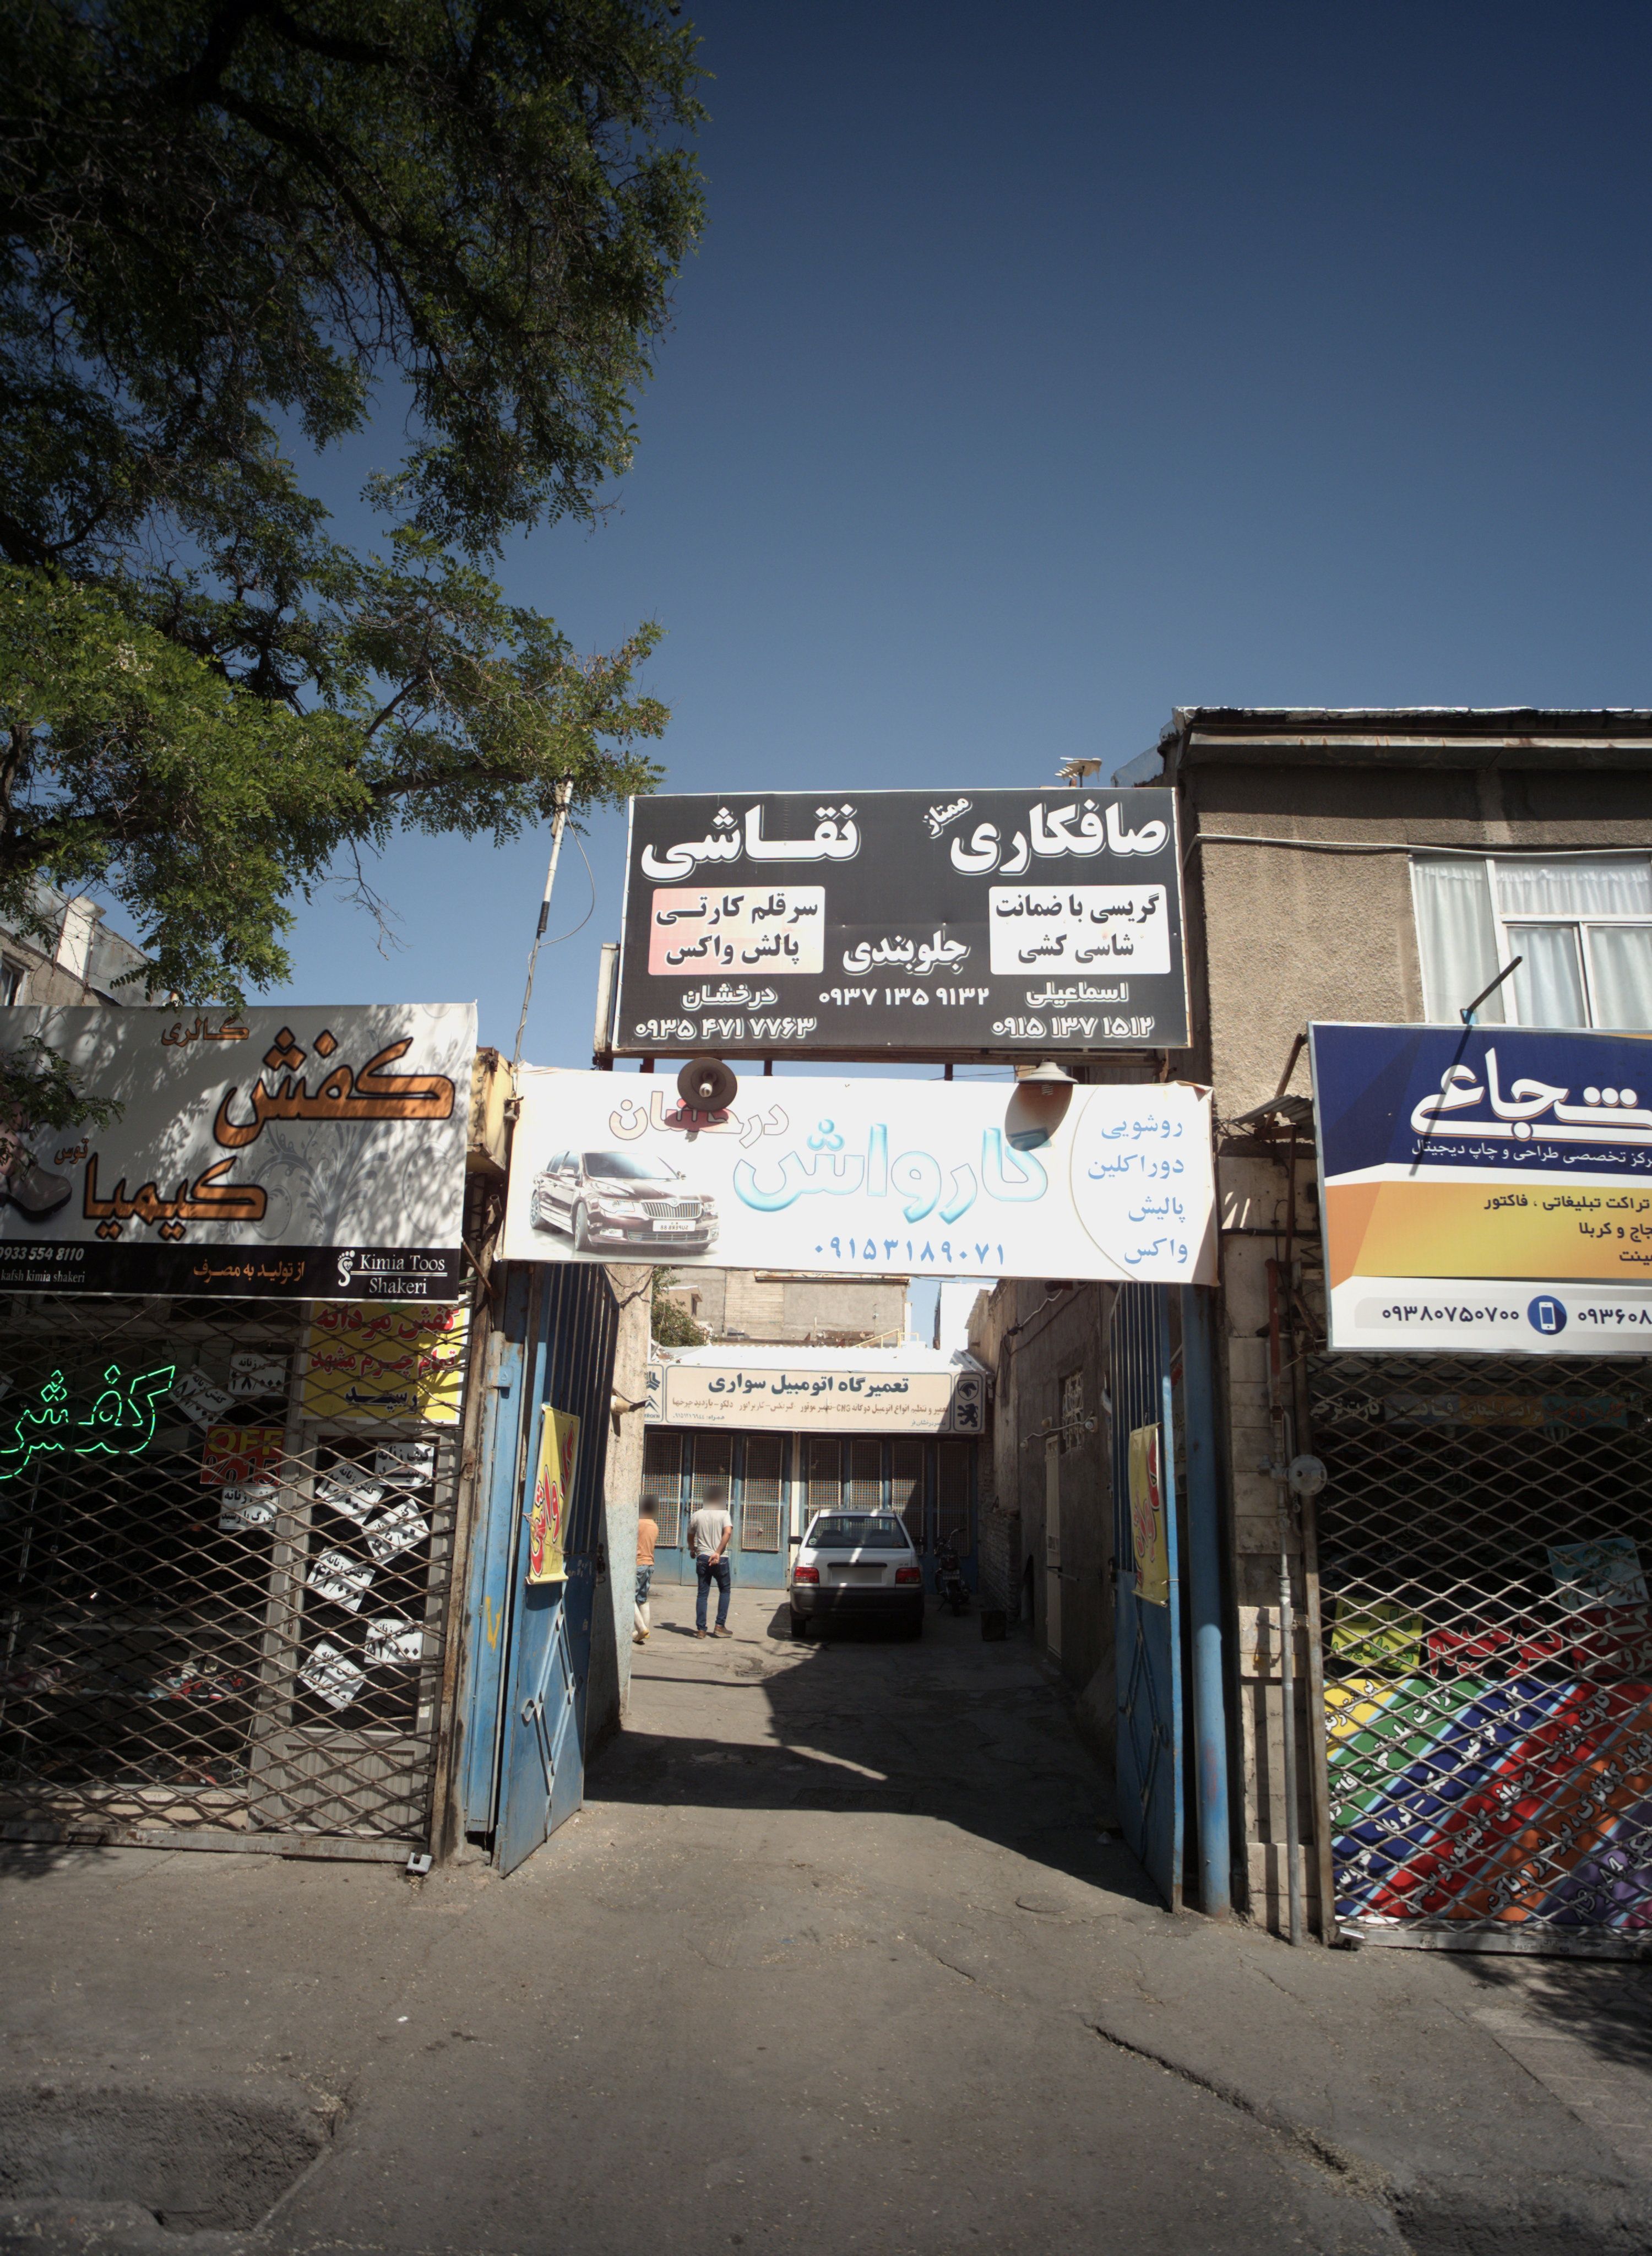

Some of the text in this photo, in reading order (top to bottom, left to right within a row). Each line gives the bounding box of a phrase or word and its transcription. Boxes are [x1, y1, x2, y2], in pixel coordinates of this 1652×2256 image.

[923, 798, 972, 838] ممتاز
[641, 799, 1170, 882] صافکاری نقاشی
[656, 895, 745, 925] کارتی
[996, 892, 1160, 924] گریسی با ضمانت
[742, 934, 799, 965] پالش
[843, 930, 971, 975] جلوبندی
[1018, 934, 1134, 963] شاسی کشی
[681, 982, 778, 1010] درخشان
[819, 988, 990, 1005] ۰۹۳۷ ۱۳۵ ۹۱۳۲
[1025, 981, 1130, 1007] اسماعیلی
[634, 1016, 817, 1039] ۰۹۳۵ ۴۷۱ ۷۷۶۳
[992, 1015, 1155, 1038] ۰۹۱۵ ۱۳۷ ۱۵۱۲
[214, 1027, 455, 1148] کفش
[1101, 1114, 1183, 1140] روشویی
[1411, 1138, 1652, 1168] رکز تخصصی طراحی و چاپ دیجیتال
[733, 1118, 1052, 1225] کارواش
[83, 1153, 268, 1240] کیمیا
[1128, 1196, 1185, 1223] پالیش
[1484, 1194, 1650, 1212] تراکت تبلیغاتی فاکتور
[1579, 1222, 1612, 1238] کربلا
[1617, 1226, 1624, 1238] و
[29, 1247, 54, 1261] 554
[56, 1248, 85, 1261] 8110
[360, 1254, 445, 1271] Kimia Toos
[814, 1236, 1005, 1265] ۰۹۱۵۳۱۸۹۰۷۱
[1124, 1238, 1188, 1265] واکس
[1, 1268, 85, 1283] kafsh kimia shakeri
[193, 1259, 305, 1284] از تولید به مصرف
[368, 1278, 427, 1295] Shakeri
[316, 1303, 461, 1341] کفش مردانه
[1382, 1305, 1519, 1323] ۰۹۳۸۰۷۵۰۷۰۰
[311, 1347, 357, 1375] مشهد
[361, 1353, 414, 1378] چرم
[708, 1373, 909, 1397] تعمیرگاه اتومبیل سواری
[345, 1386, 418, 1414] رسید
[206, 1427, 284, 1456] OFF
[407, 1447, 432, 1465] کیف
